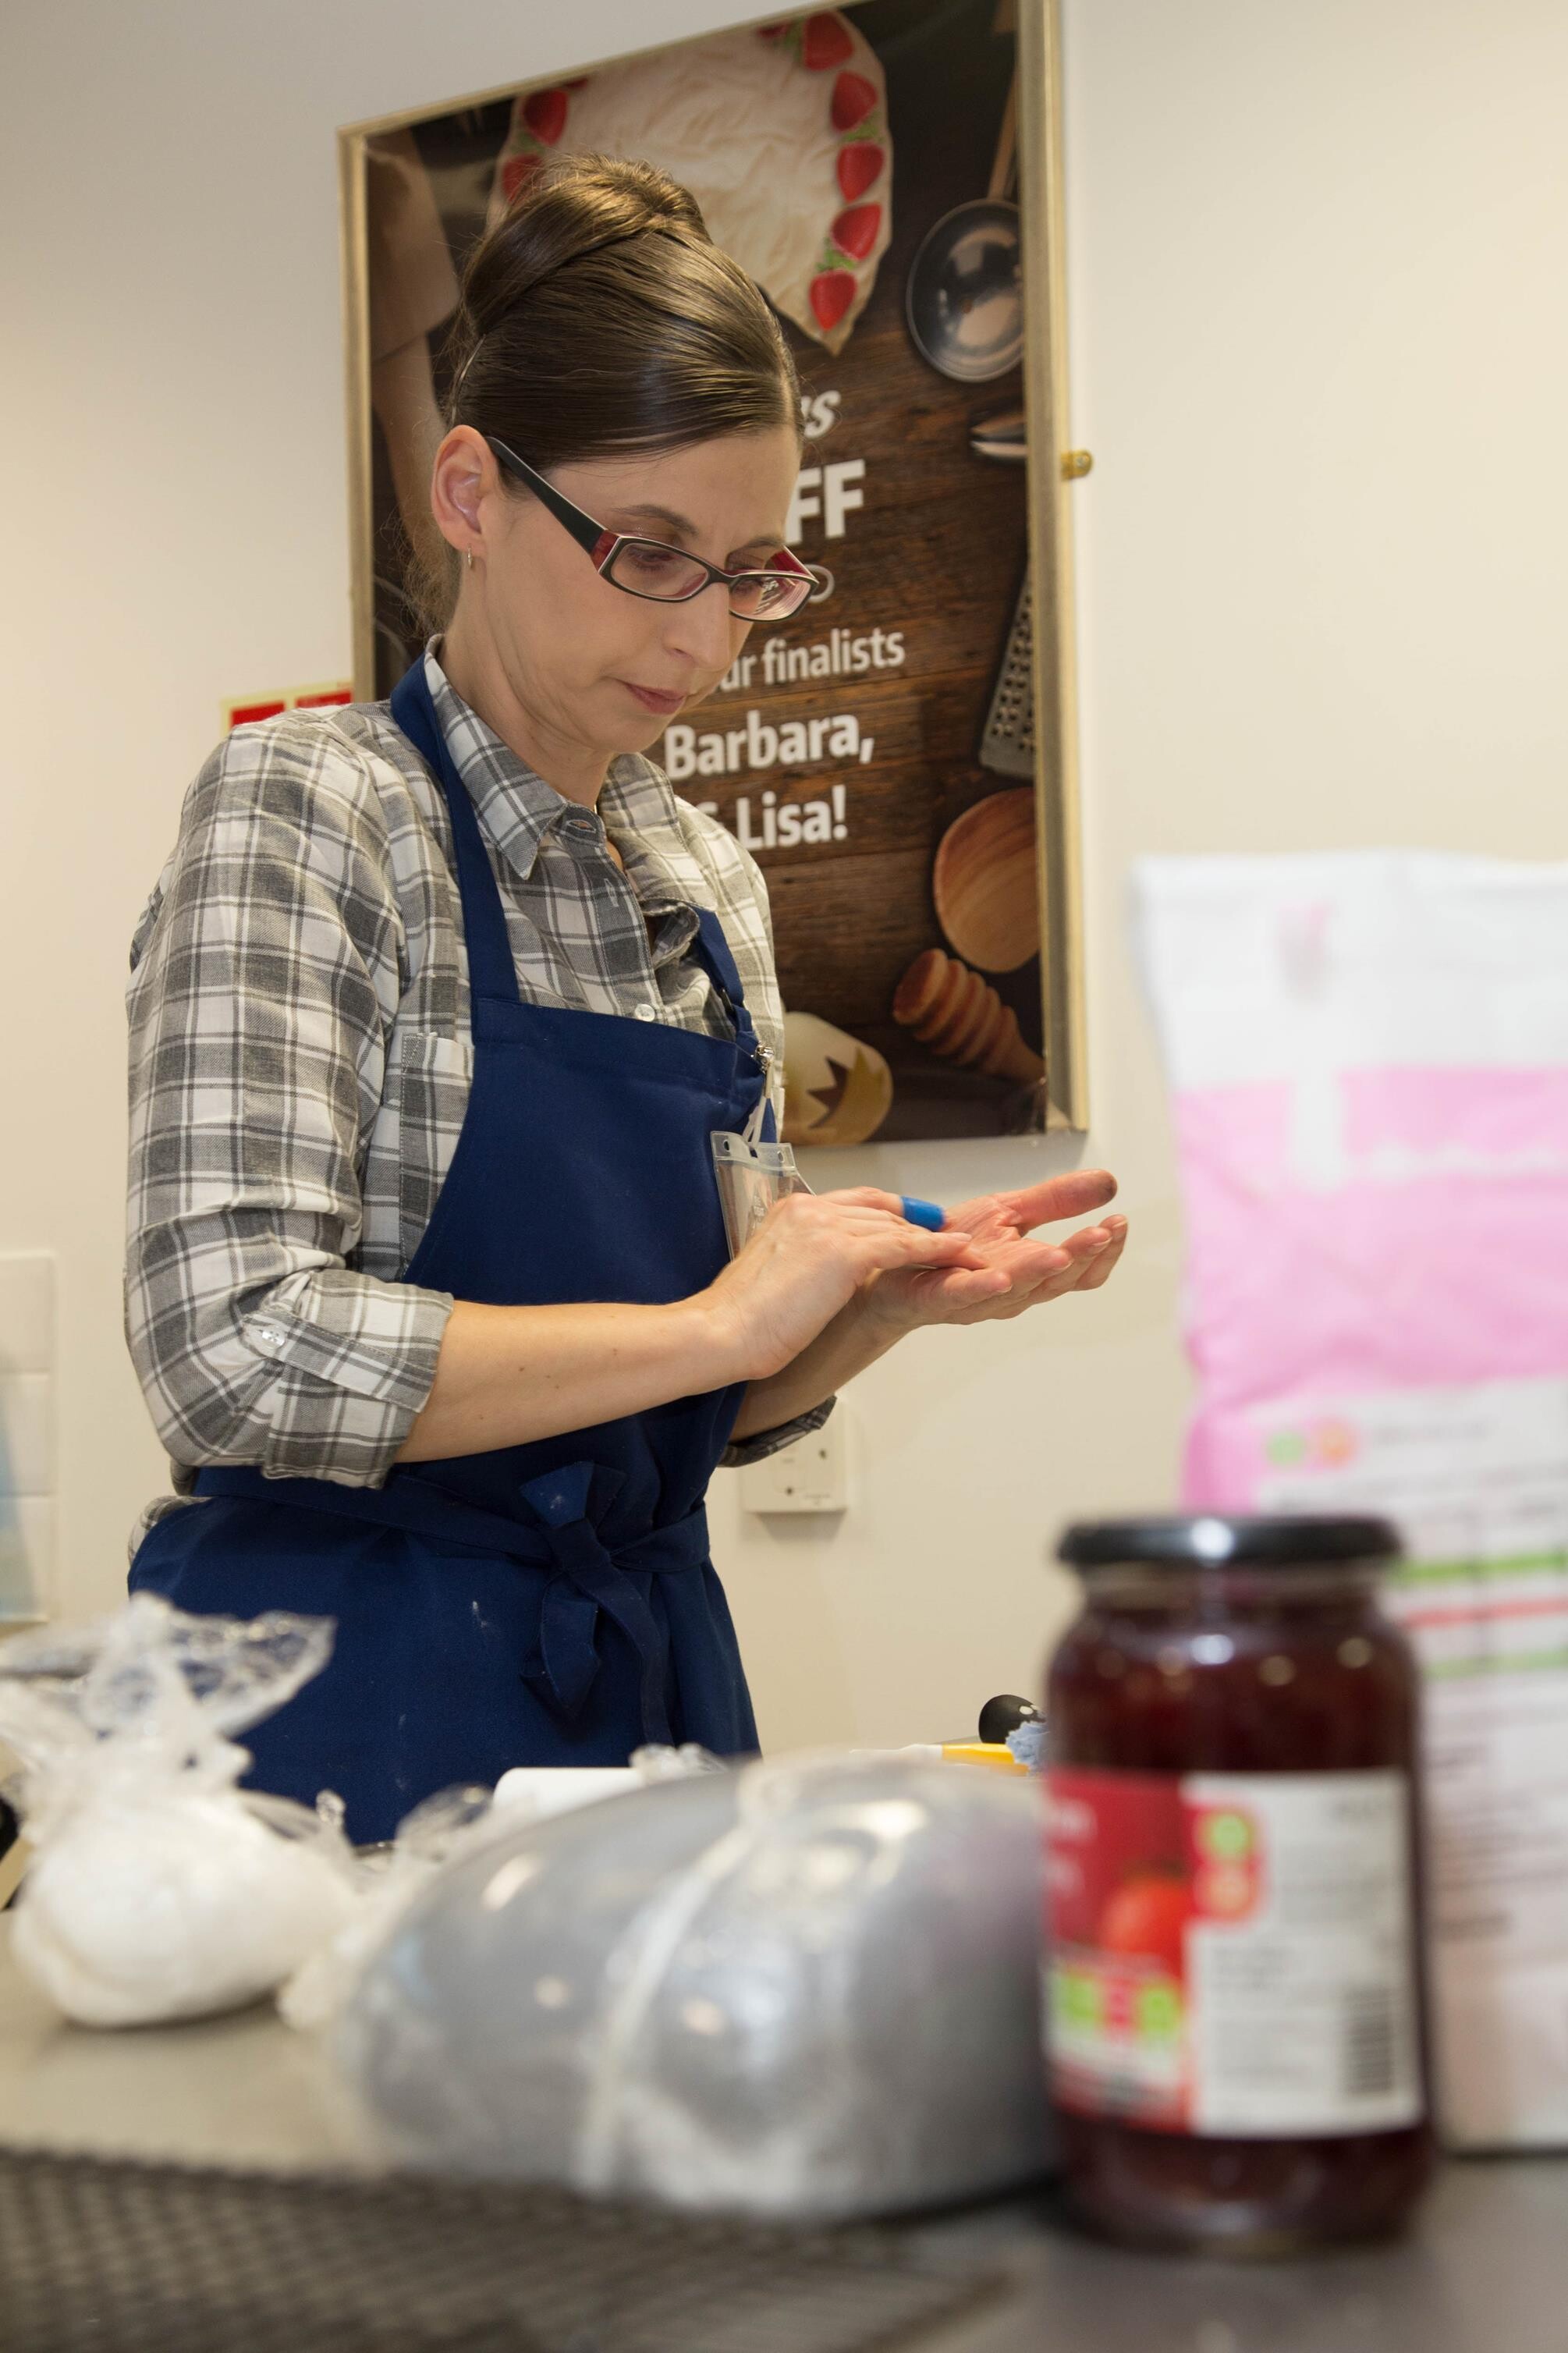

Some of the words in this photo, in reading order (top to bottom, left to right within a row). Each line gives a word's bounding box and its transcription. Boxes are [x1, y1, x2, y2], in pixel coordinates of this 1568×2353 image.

[784, 458, 865, 545] FF
[719, 655, 757, 692] ur
[761, 627, 905, 685] finalists
[664, 709, 874, 780] Barbara,
[736, 784, 848, 850] Lisa!
